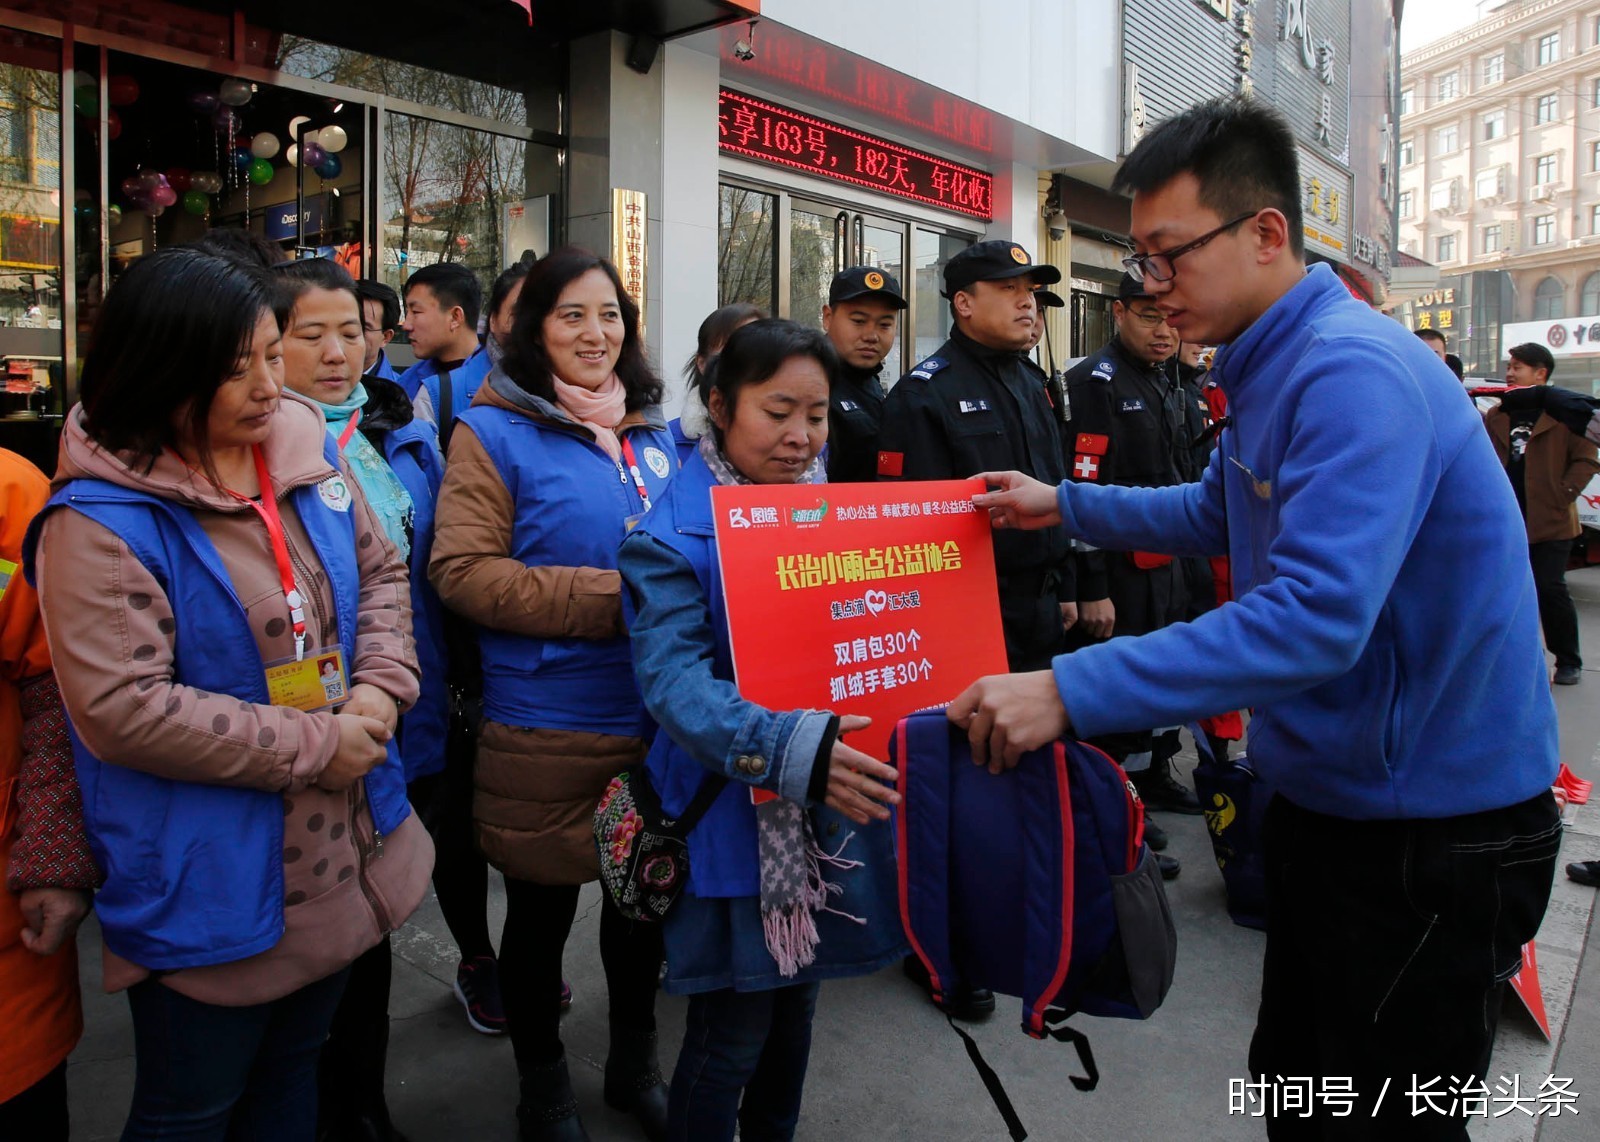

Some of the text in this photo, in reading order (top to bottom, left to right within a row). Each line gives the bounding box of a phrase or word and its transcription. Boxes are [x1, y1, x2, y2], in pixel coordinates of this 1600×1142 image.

[625, 202, 642, 299] 中共山西金尚品
[1415, 288, 1454, 307] LOVE
[1418, 310, 1452, 330] 发型
[836, 505, 877, 521] 热心公益
[882, 502, 920, 518] 奉献爱心
[776, 540, 961, 591] 长治小雨点公益协会
[831, 591, 920, 620] 集点滴 汇大爱
[833, 628, 921, 667] 双肩包30个
[829, 657, 933, 702] 抓绒手套30个
